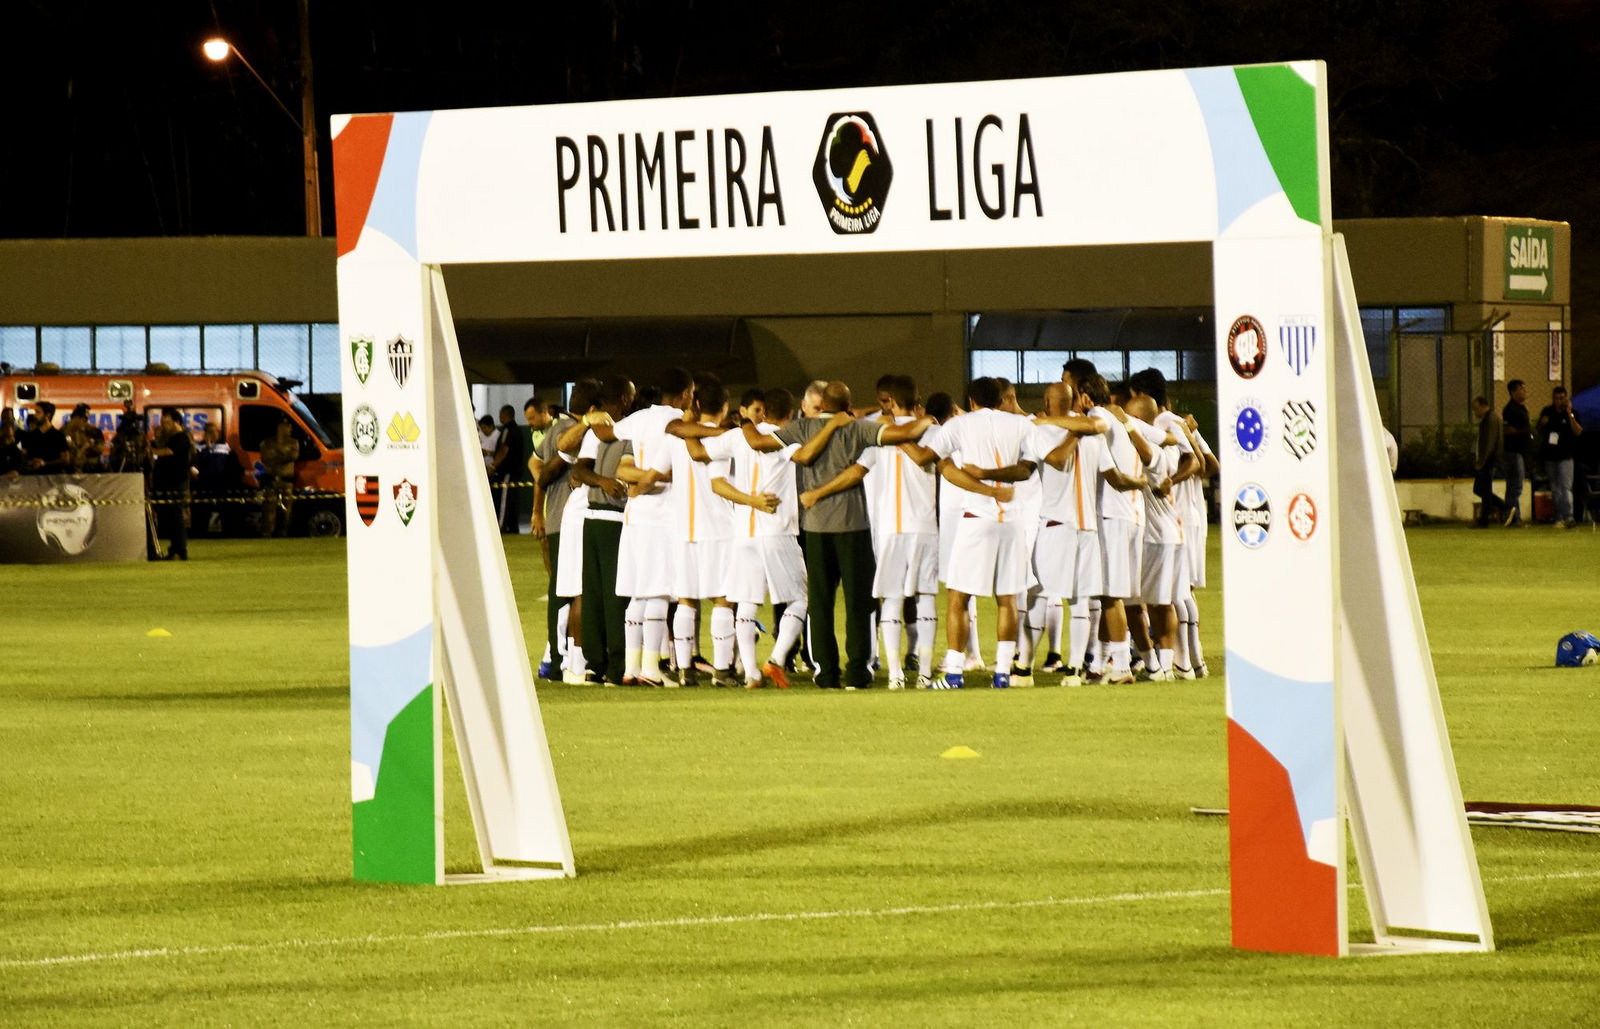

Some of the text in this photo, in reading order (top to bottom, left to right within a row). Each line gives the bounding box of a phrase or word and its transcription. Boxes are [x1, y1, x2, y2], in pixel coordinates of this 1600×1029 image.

[556, 113, 1044, 233] PRIMEIRA LIGA
[830, 206, 881, 232] PRIMEIRA LIGA
[1510, 228, 1549, 269] SAÍDA
